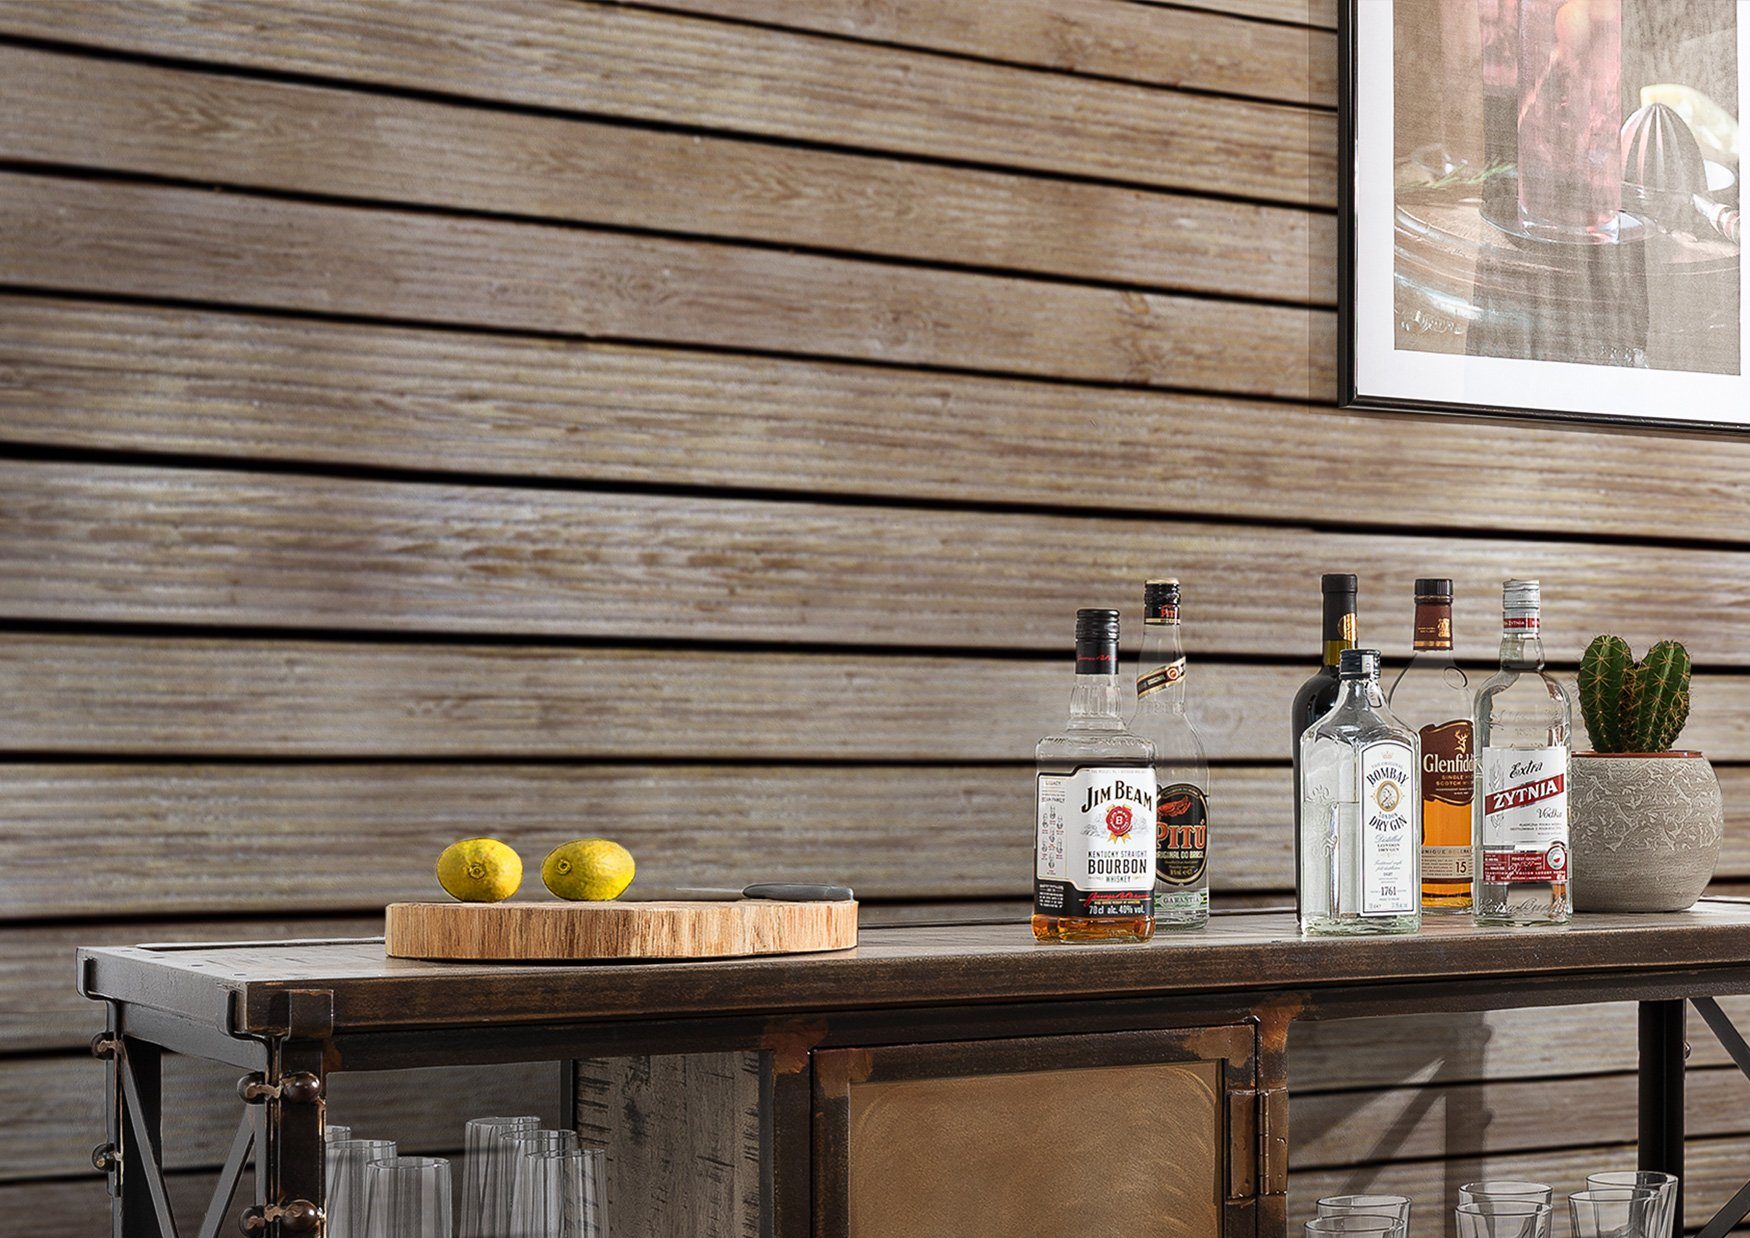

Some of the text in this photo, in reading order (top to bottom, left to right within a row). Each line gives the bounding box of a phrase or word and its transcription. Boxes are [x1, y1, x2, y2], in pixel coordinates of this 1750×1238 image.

[1366, 766, 1410, 786] BOMBAY
[1509, 760, 1544, 779] Extra
[1081, 780, 1153, 814] JIM BEAM
[1368, 814, 1408, 832] DRY GIN
[1087, 850, 1148, 859] KENTUCKY STRAIGHT
[1087, 859, 1147, 875] BOURBON
[1455, 861, 1467, 873] 15
[1381, 886, 1397, 897] 1761
[1119, 905, 1133, 914] 40%
